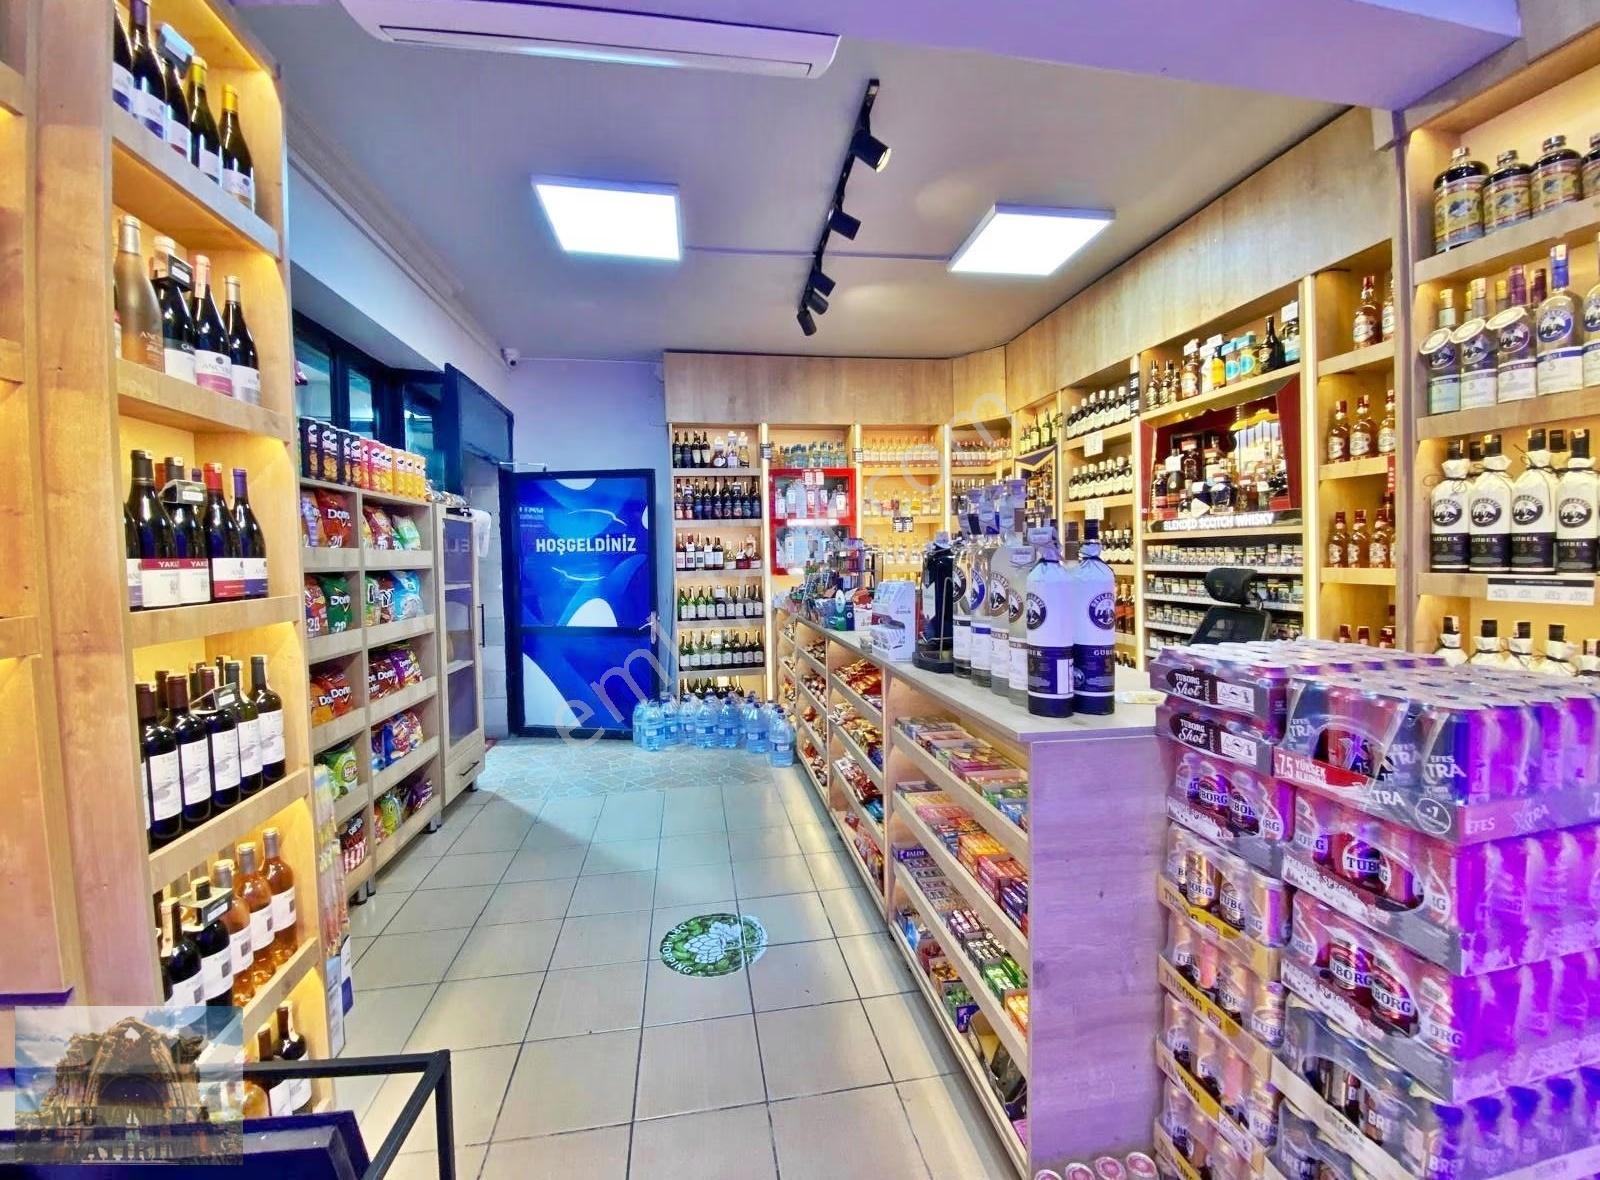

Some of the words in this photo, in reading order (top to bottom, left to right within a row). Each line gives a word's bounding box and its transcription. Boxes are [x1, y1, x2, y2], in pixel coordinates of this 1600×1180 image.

[536, 533, 637, 556] HOŞGELDİNİZ
[1175, 673, 1200, 684] TUBORG
[1173, 681, 1202, 696] Shot
[1180, 719, 1205, 732] TUBORG
[1178, 728, 1208, 744] Shot
[1465, 817, 1495, 835] EFES
[670, 924, 687, 940] DRY
[661, 941, 694, 974] HOPPING
